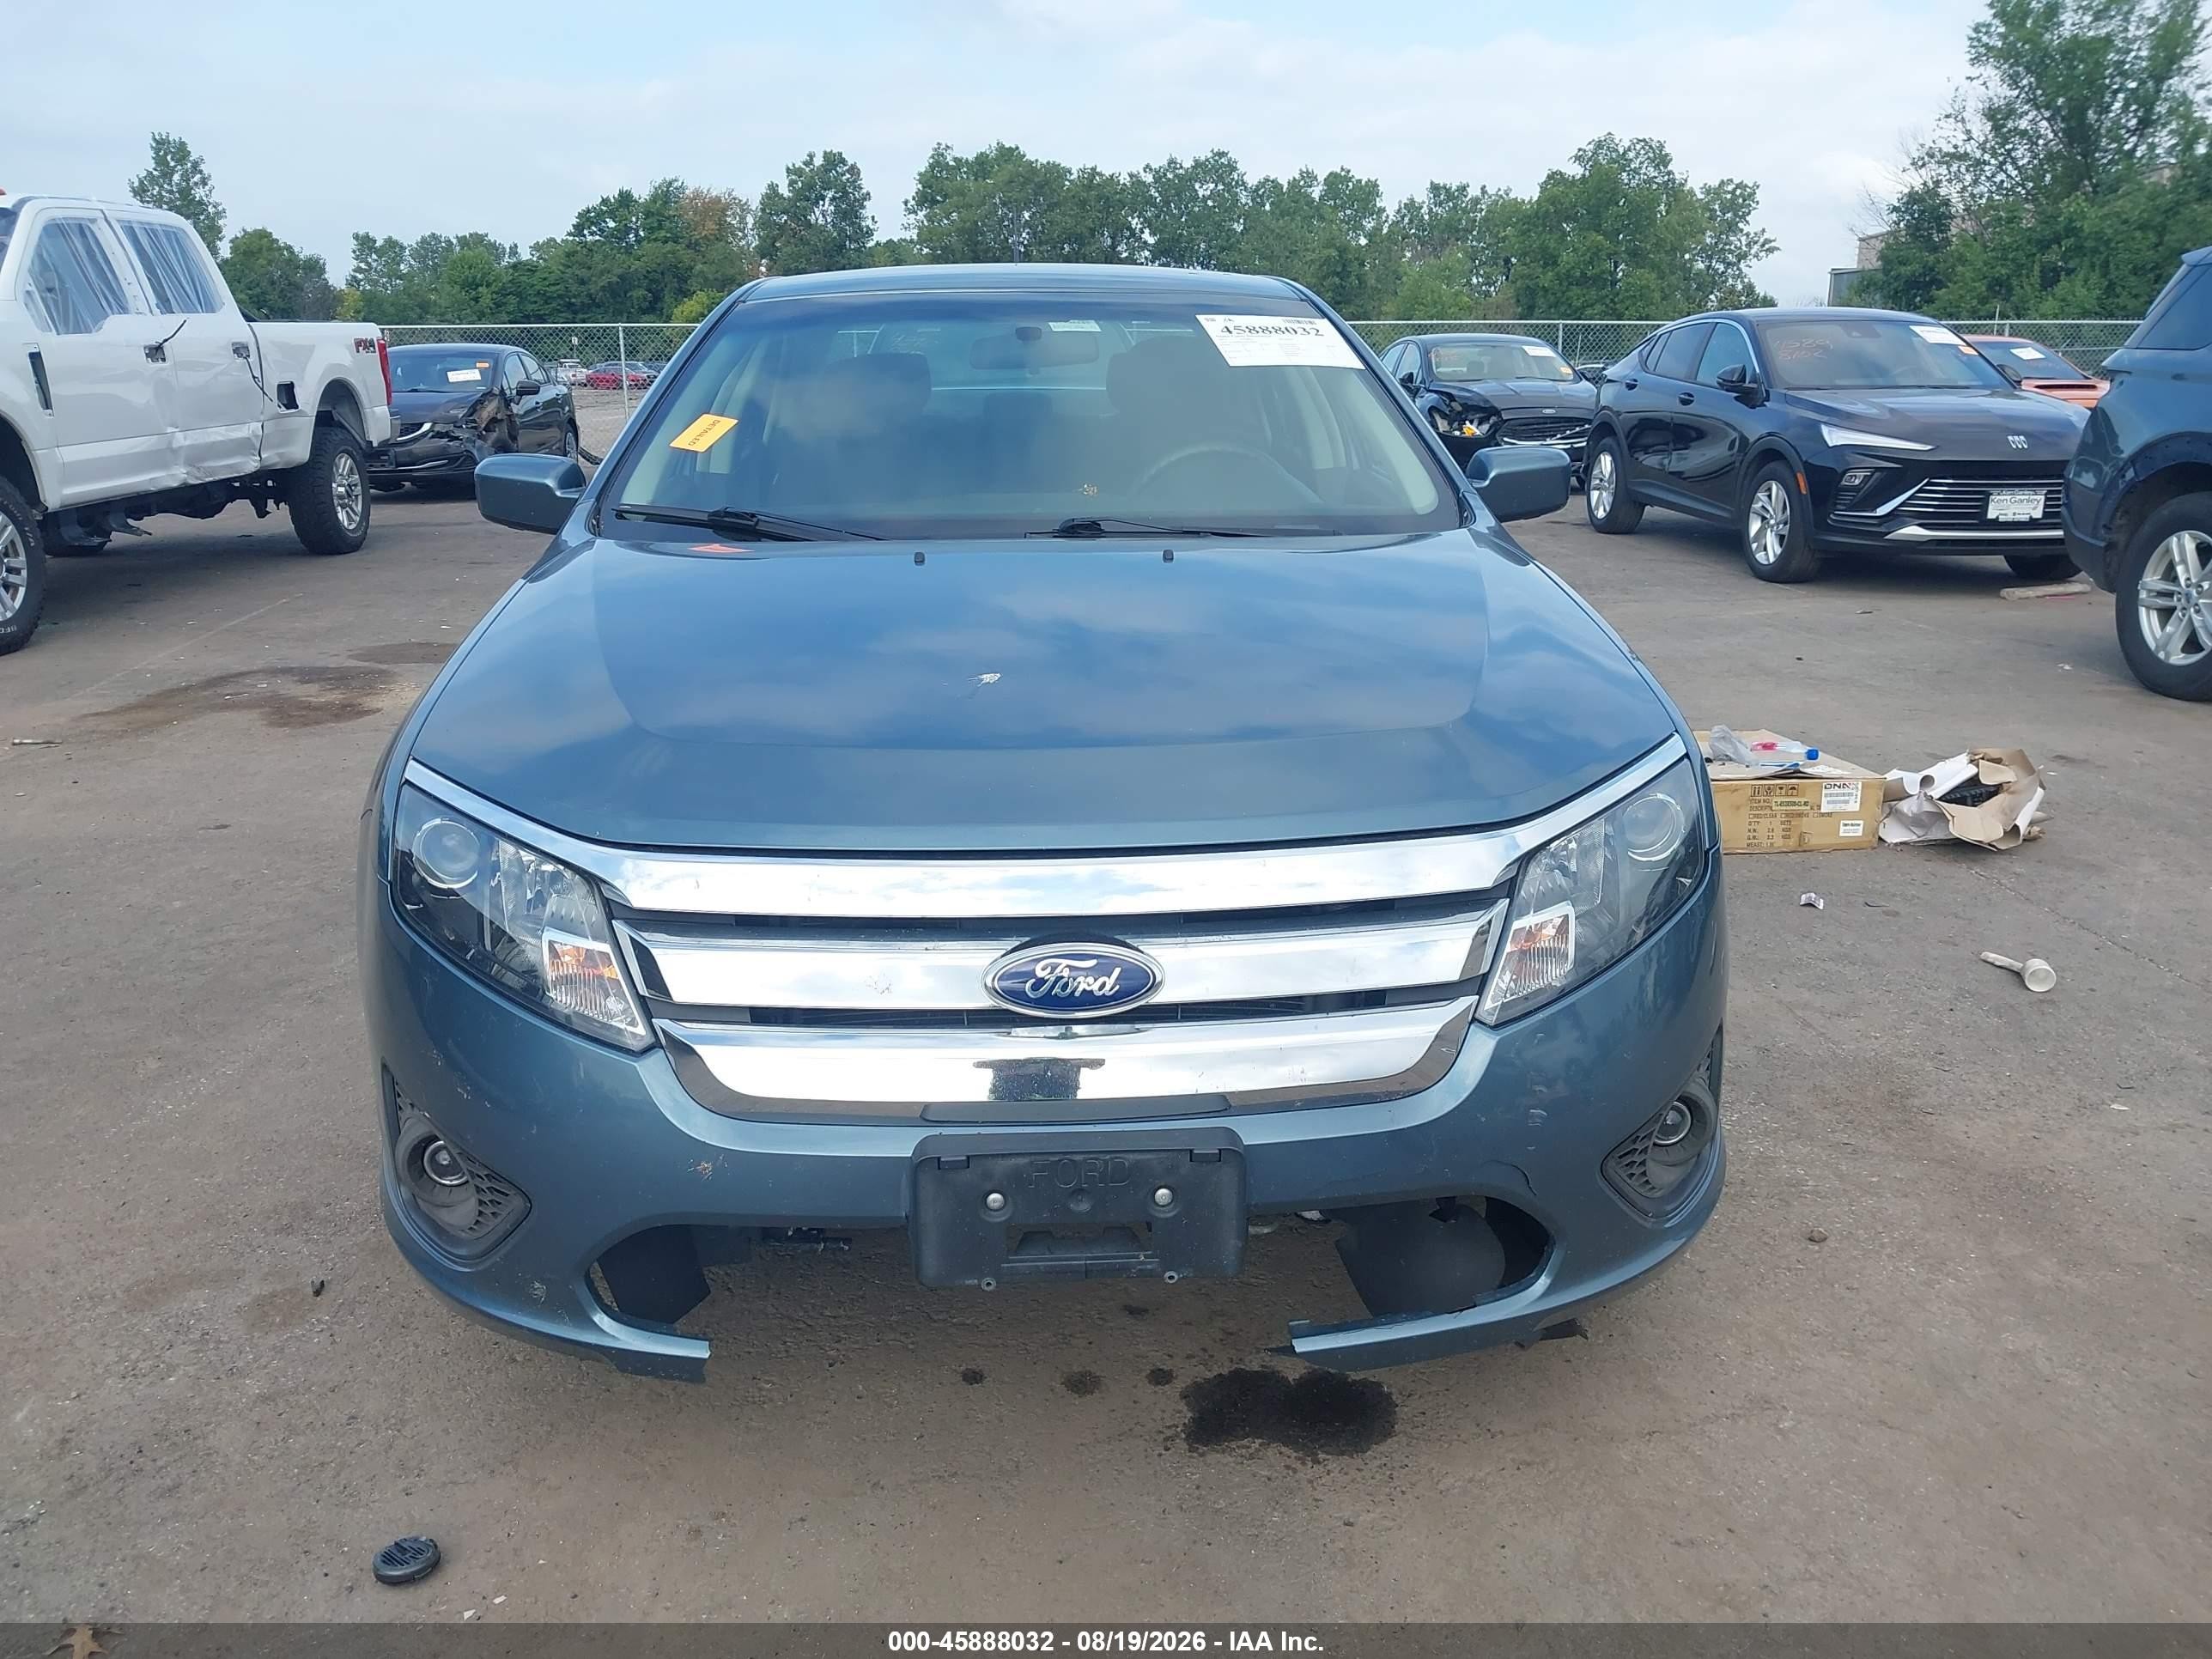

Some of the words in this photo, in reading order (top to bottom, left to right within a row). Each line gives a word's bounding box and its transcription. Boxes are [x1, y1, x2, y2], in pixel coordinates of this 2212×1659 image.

[1220, 325, 1325, 337] 45888032
[353, 337, 376, 353] FX4
[688, 419, 721, 447] DETAILED
[2009, 496, 2042, 505] Ganley
[1025, 958, 1121, 999] Ford
[1028, 1158, 1130, 1188] FORD
